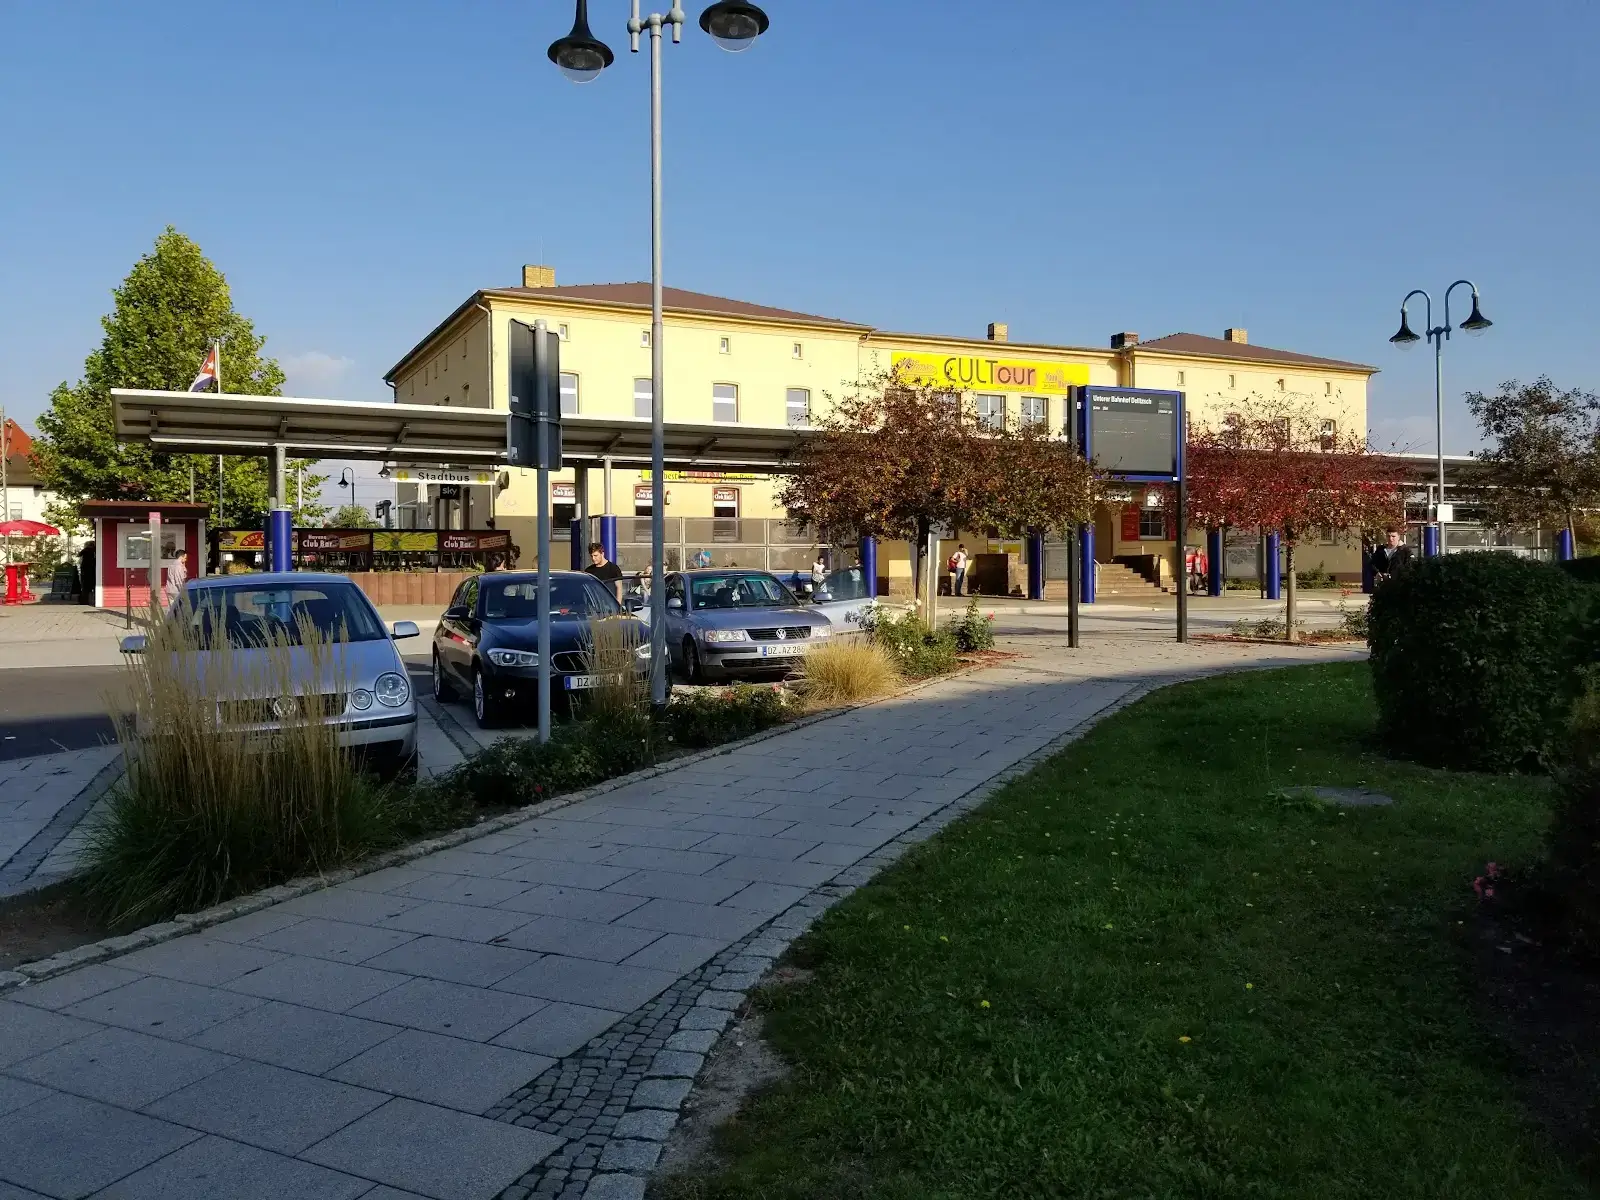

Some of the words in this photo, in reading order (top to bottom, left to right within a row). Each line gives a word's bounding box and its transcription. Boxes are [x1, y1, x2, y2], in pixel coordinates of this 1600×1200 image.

[944, 357, 1036, 386] CULTour
[1111, 395, 1130, 403] Bahnhof
[418, 472, 470, 481] Stadtbus
[442, 486, 457, 496] sky
[242, 534, 258, 546] Star
[319, 540, 333, 548] Bar
[459, 541, 471, 549] Bar
[576, 677, 589, 687] DZ
